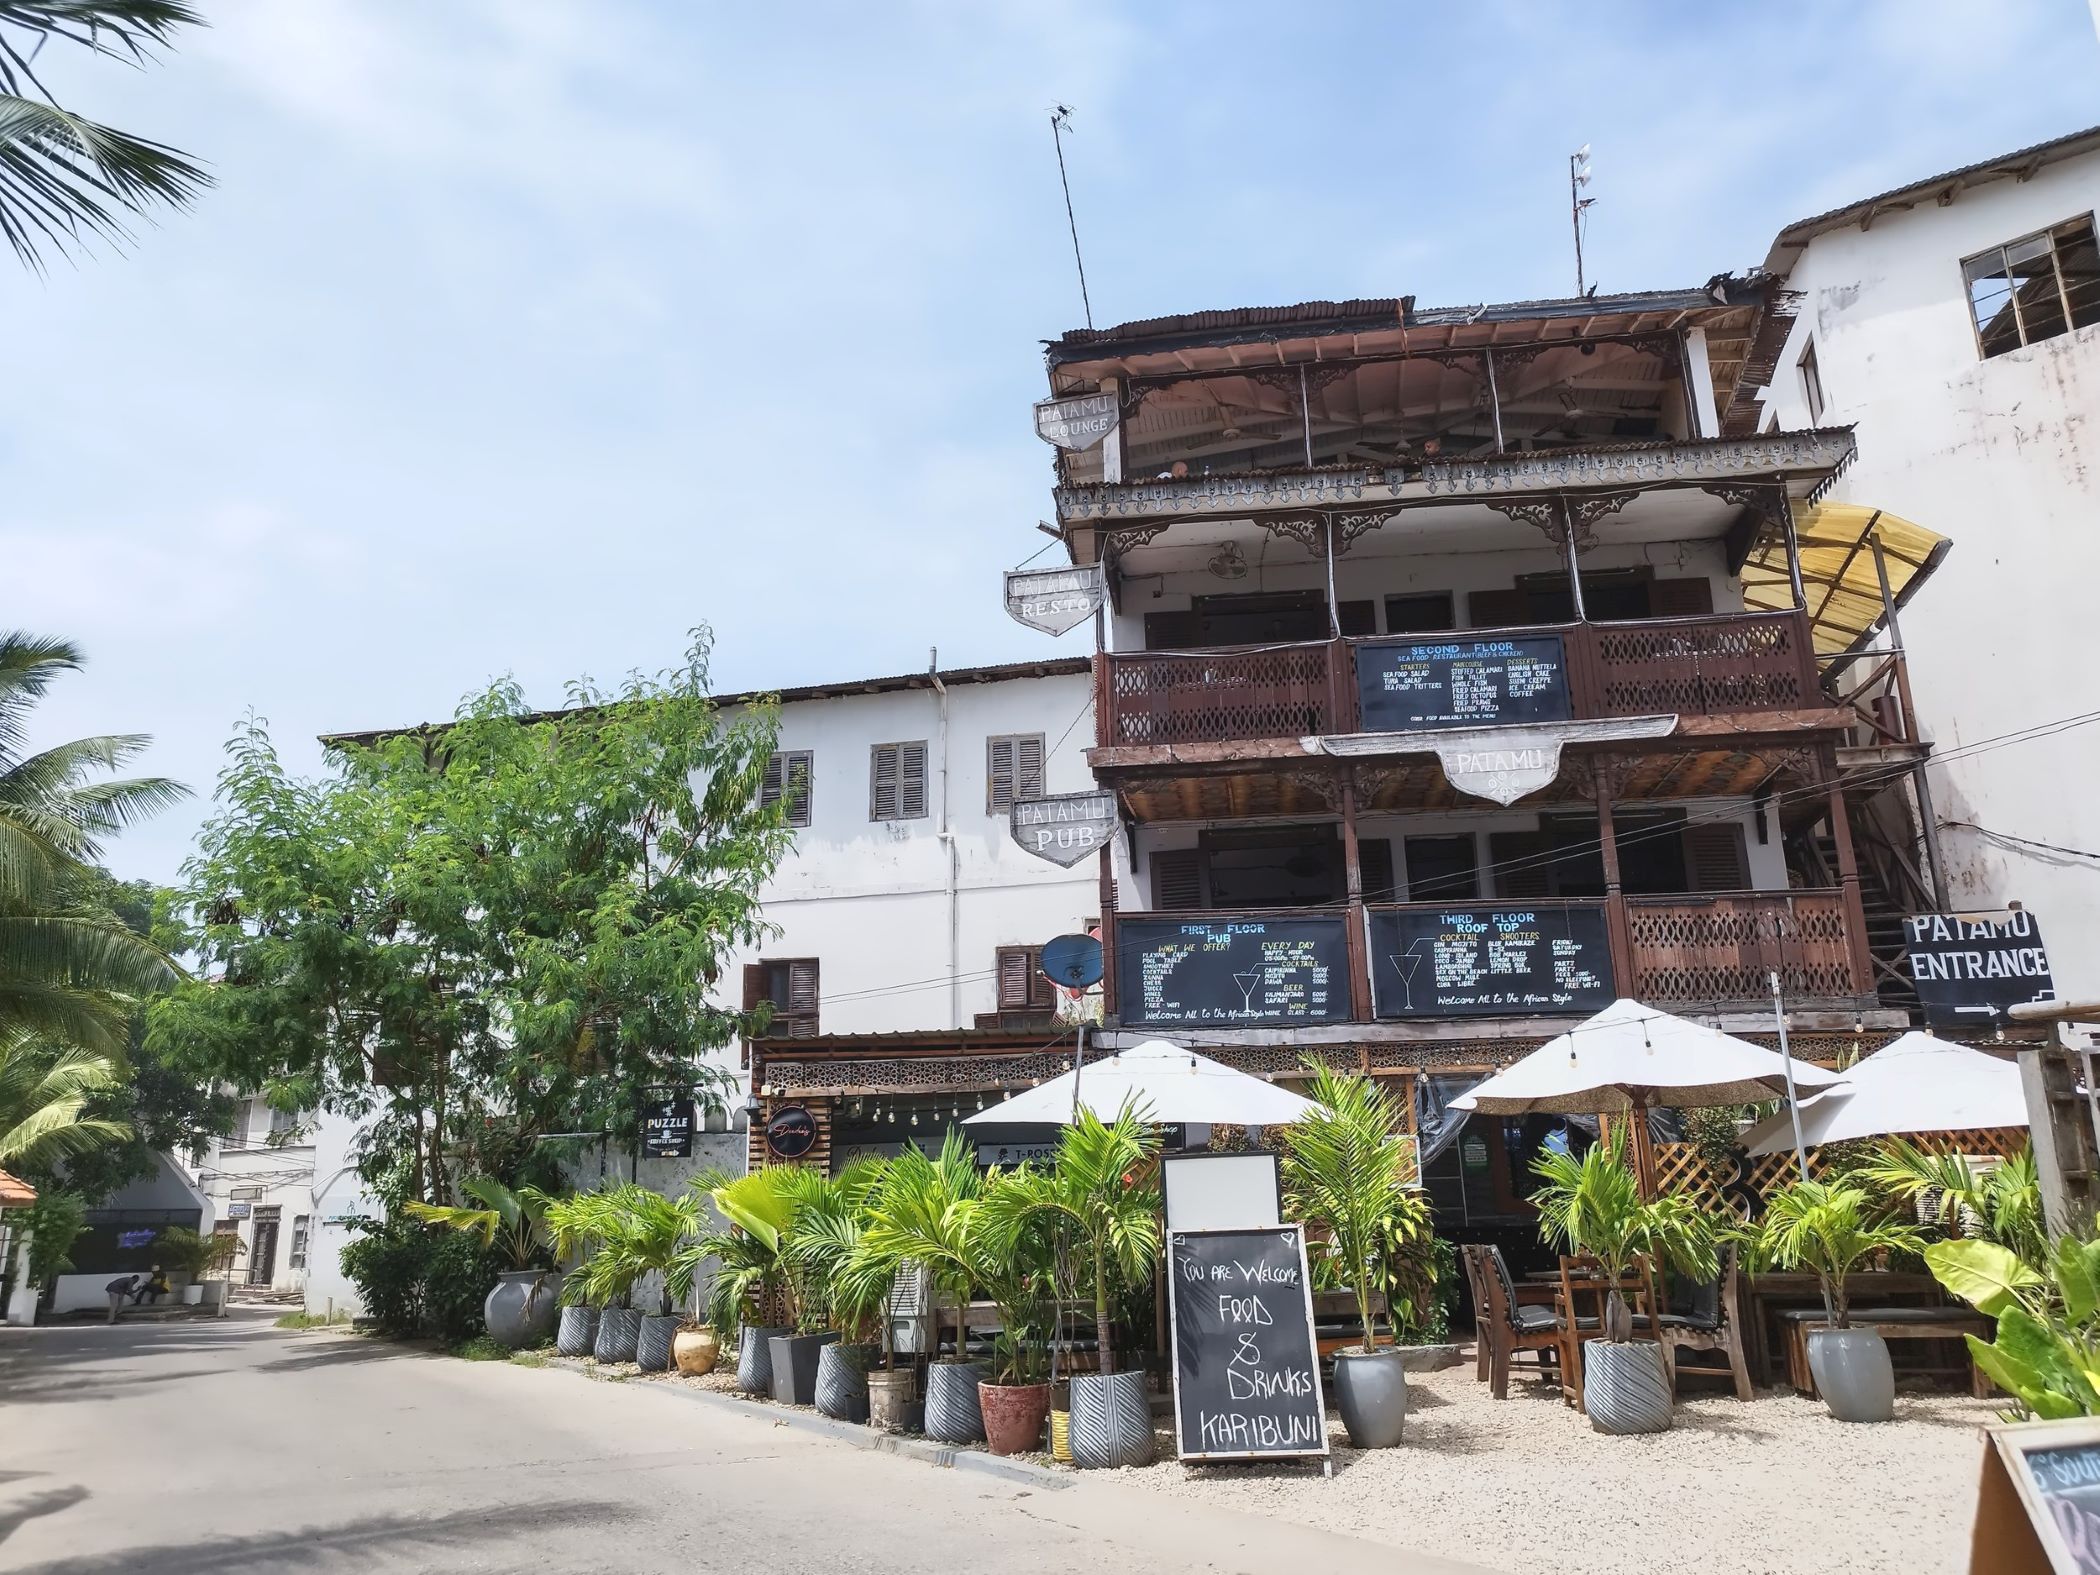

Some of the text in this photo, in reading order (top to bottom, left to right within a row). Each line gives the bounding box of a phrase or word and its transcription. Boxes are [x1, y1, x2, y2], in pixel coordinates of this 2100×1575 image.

[1049, 418, 1108, 438] LOUNGE
[1021, 597, 1091, 618] RESTO
[1411, 642, 1514, 656] SECOND FLOOR
[1400, 663, 1430, 671] STARTERS
[1506, 658, 1538, 666] DESSERTS
[1523, 683, 1546, 691] CREAM
[1509, 690, 1534, 698] COFFEE
[1480, 704, 1500, 712] PIZZA
[1456, 749, 1542, 773] PATAMU
[1021, 797, 1108, 825] PATAMU
[1035, 827, 1095, 852] PUB
[1440, 913, 1535, 925] THIRD FLOOR
[1181, 923, 1266, 935] FIRST FLOOR
[1456, 922, 1520, 933] ROOF TOP
[1207, 933, 1232, 943] PUB
[1440, 933, 1480, 942] COCKTAIL
[1500, 931, 1540, 941] SHOOTERS
[1158, 943, 1231, 953] WHAT WE OFFER?
[1261, 941, 1315, 951] EVERY DAY
[1281, 960, 1320, 968] COCKTAILS
[1909, 947, 2049, 980] ENTRANCE
[1283, 984, 1304, 992] BEER
[1437, 992, 1573, 1006] Welcome All to the African Style
[1288, 1002, 1308, 1010] WINE
[1145, 1010, 1182, 1020] Welcome
[1184, 1009, 1198, 1019] All
[1201, 1008, 1211, 1018] to
[1213, 1007, 1226, 1018] the
[647, 1117, 688, 1129] PUZZLE
[1211, 1264, 1233, 1281] ARE
[1219, 1294, 1273, 1325] FOOD
[1226, 1366, 1312, 1400] DRINKS
[1200, 1410, 1318, 1449] KARIBUNI
